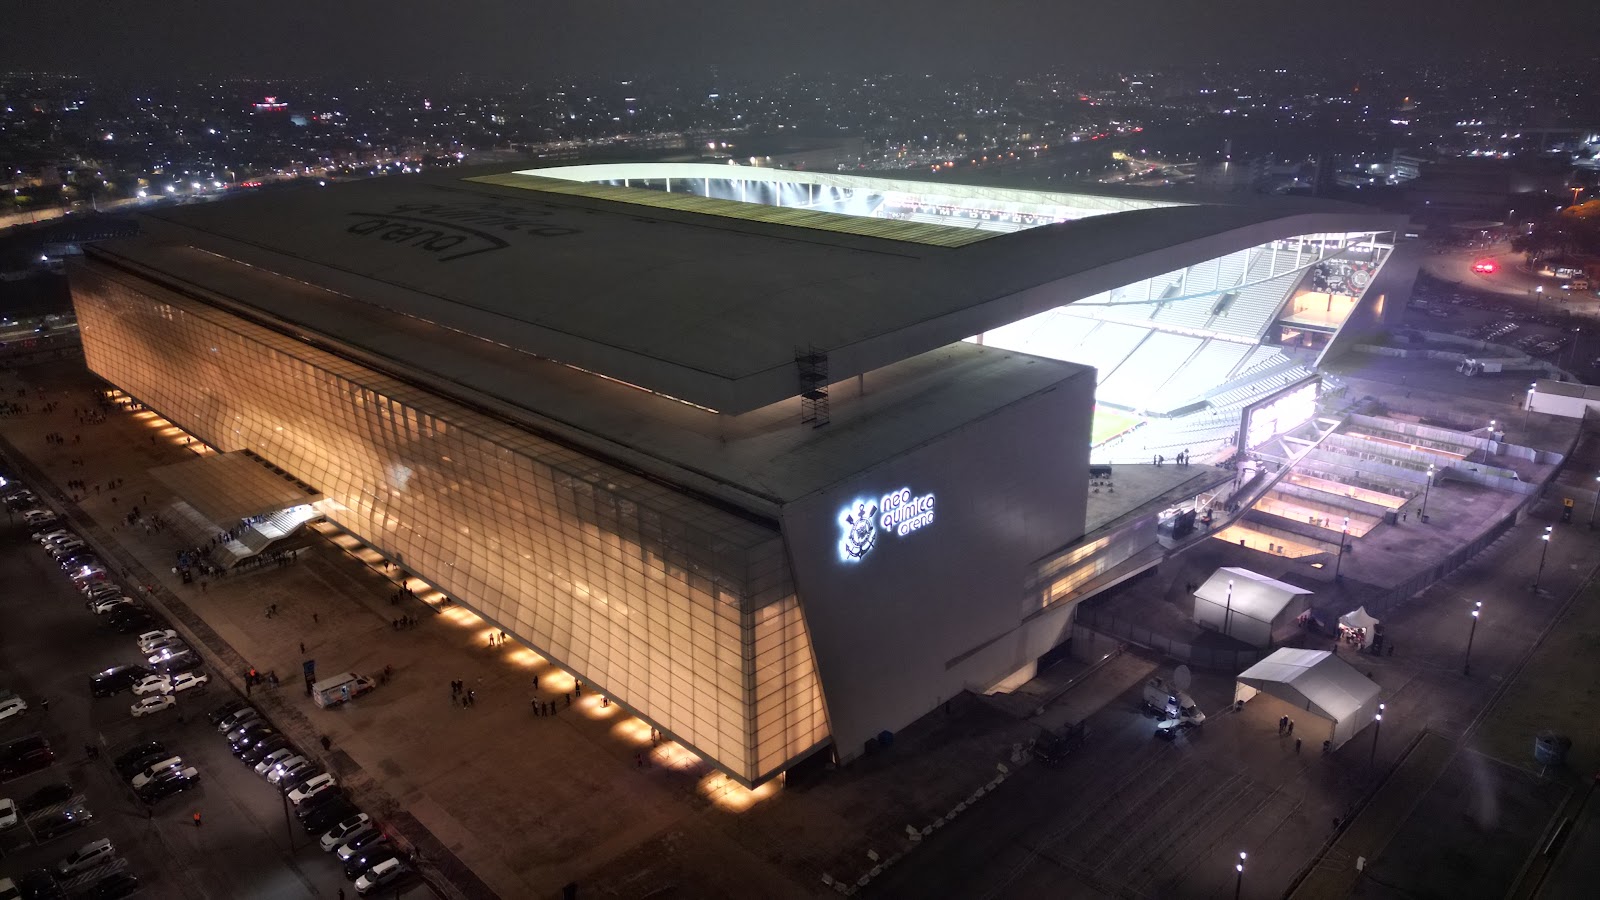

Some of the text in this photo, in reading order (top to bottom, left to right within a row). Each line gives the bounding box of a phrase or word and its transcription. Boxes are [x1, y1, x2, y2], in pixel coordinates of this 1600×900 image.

[346, 218, 469, 252] arena
[881, 488, 911, 513] neo
[898, 511, 935, 536] arena
